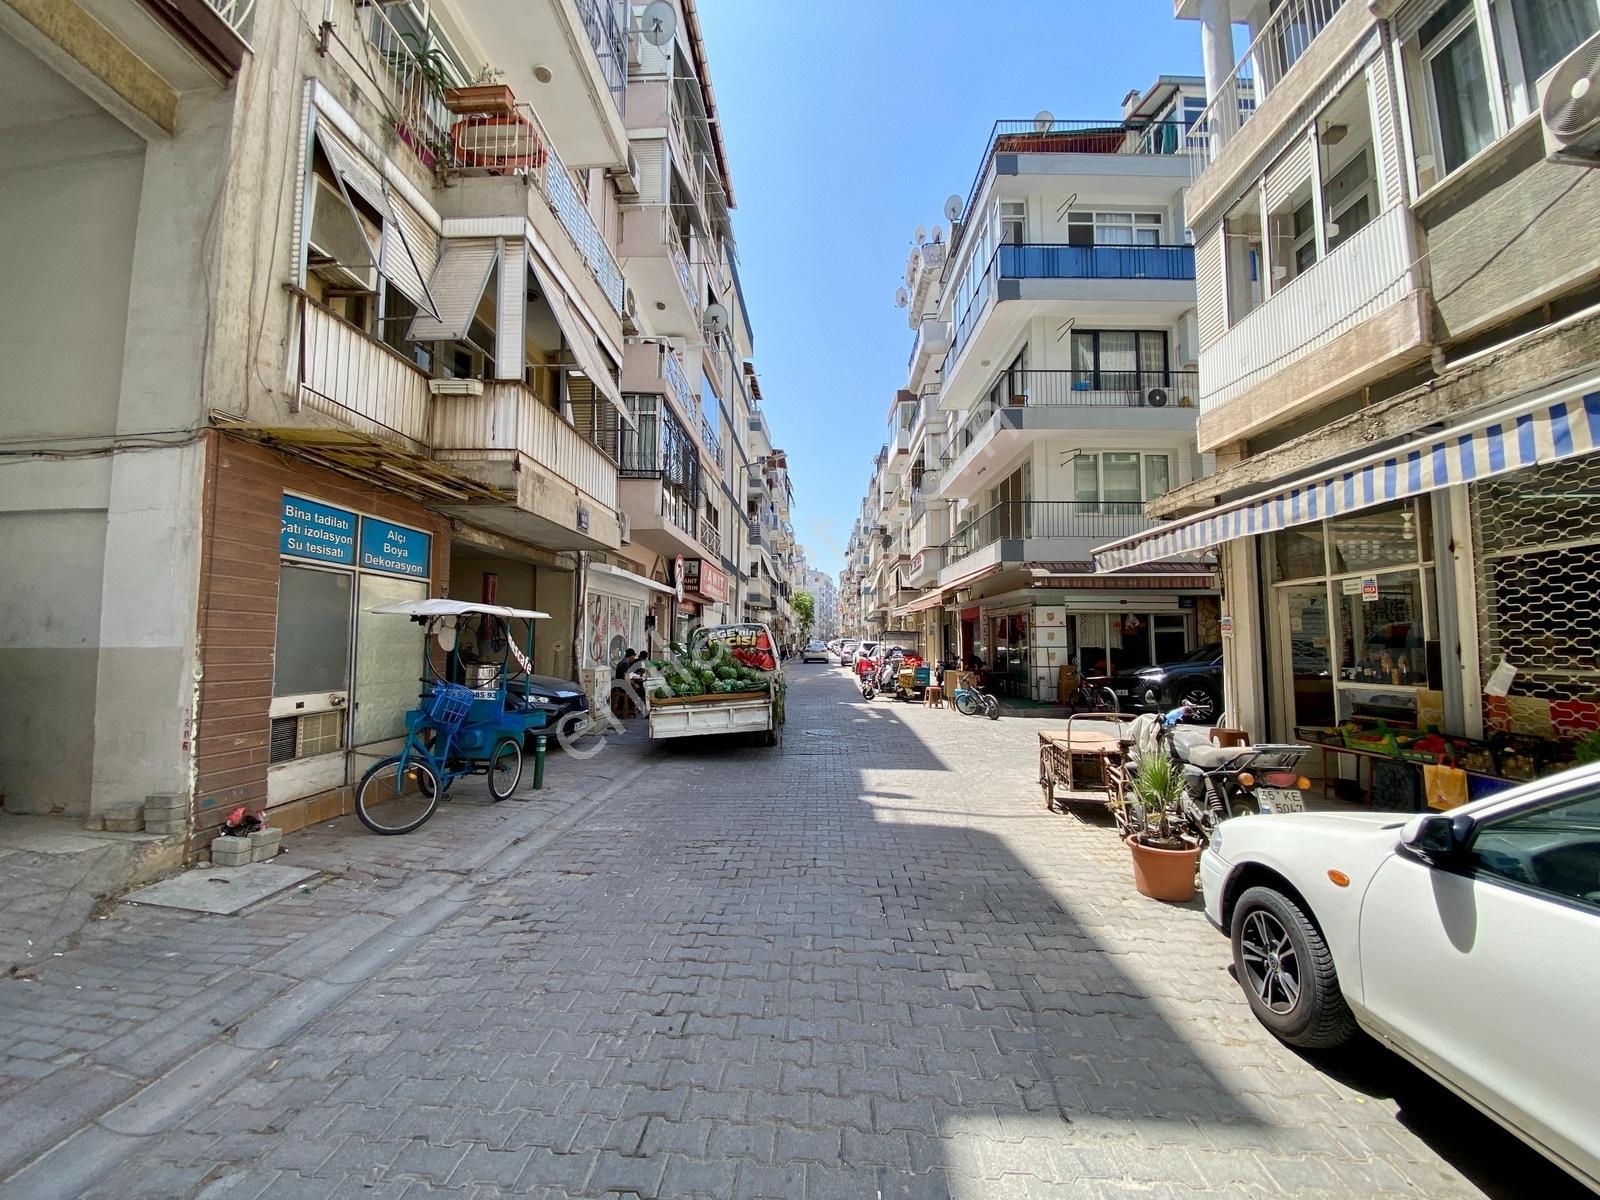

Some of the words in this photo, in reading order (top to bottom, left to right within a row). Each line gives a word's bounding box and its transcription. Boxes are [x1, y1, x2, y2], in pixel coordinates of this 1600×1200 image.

[285, 505, 312, 523] Bina
[314, 512, 349, 530] tadilatı
[304, 525, 353, 545] izolasyon
[387, 530, 406, 543] Alçı
[287, 538, 303, 551] Su
[306, 542, 344, 558] tesisatı
[383, 543, 408, 558] Boya
[365, 553, 423, 574] Dekorasyon
[1283, 791, 1301, 802] KE
